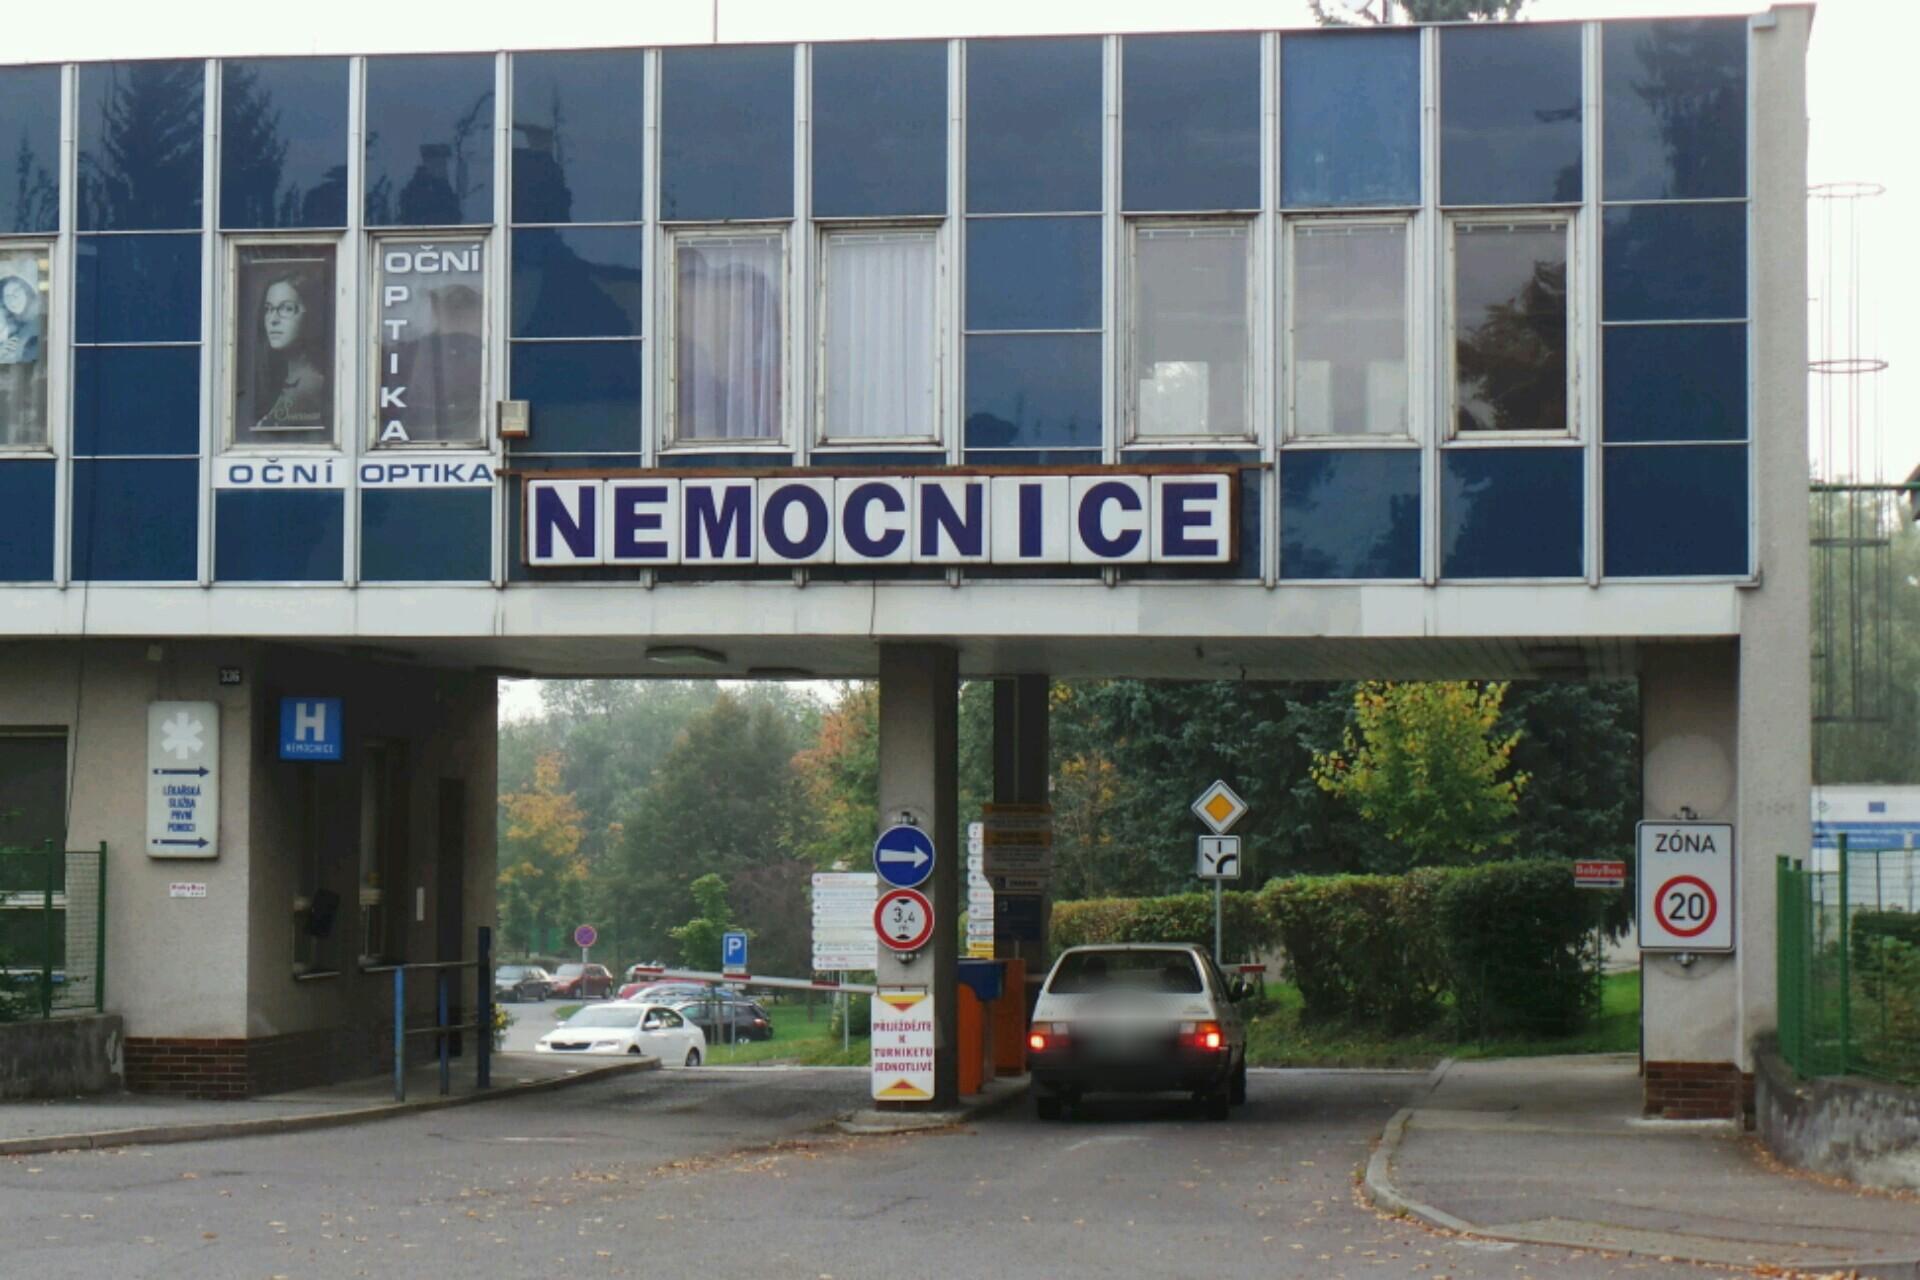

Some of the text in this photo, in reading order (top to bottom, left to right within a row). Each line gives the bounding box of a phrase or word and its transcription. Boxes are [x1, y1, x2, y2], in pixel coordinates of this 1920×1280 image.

[385, 245, 480, 274] OČNÍ
[228, 457, 494, 484] OČNÍ OPTIKA
[535, 481, 1219, 560] NEMOCNICE
[296, 703, 325, 741] H
[1655, 830, 1716, 853] ZÓNA
[1668, 893, 1705, 920] 20
[728, 937, 741, 956] P
